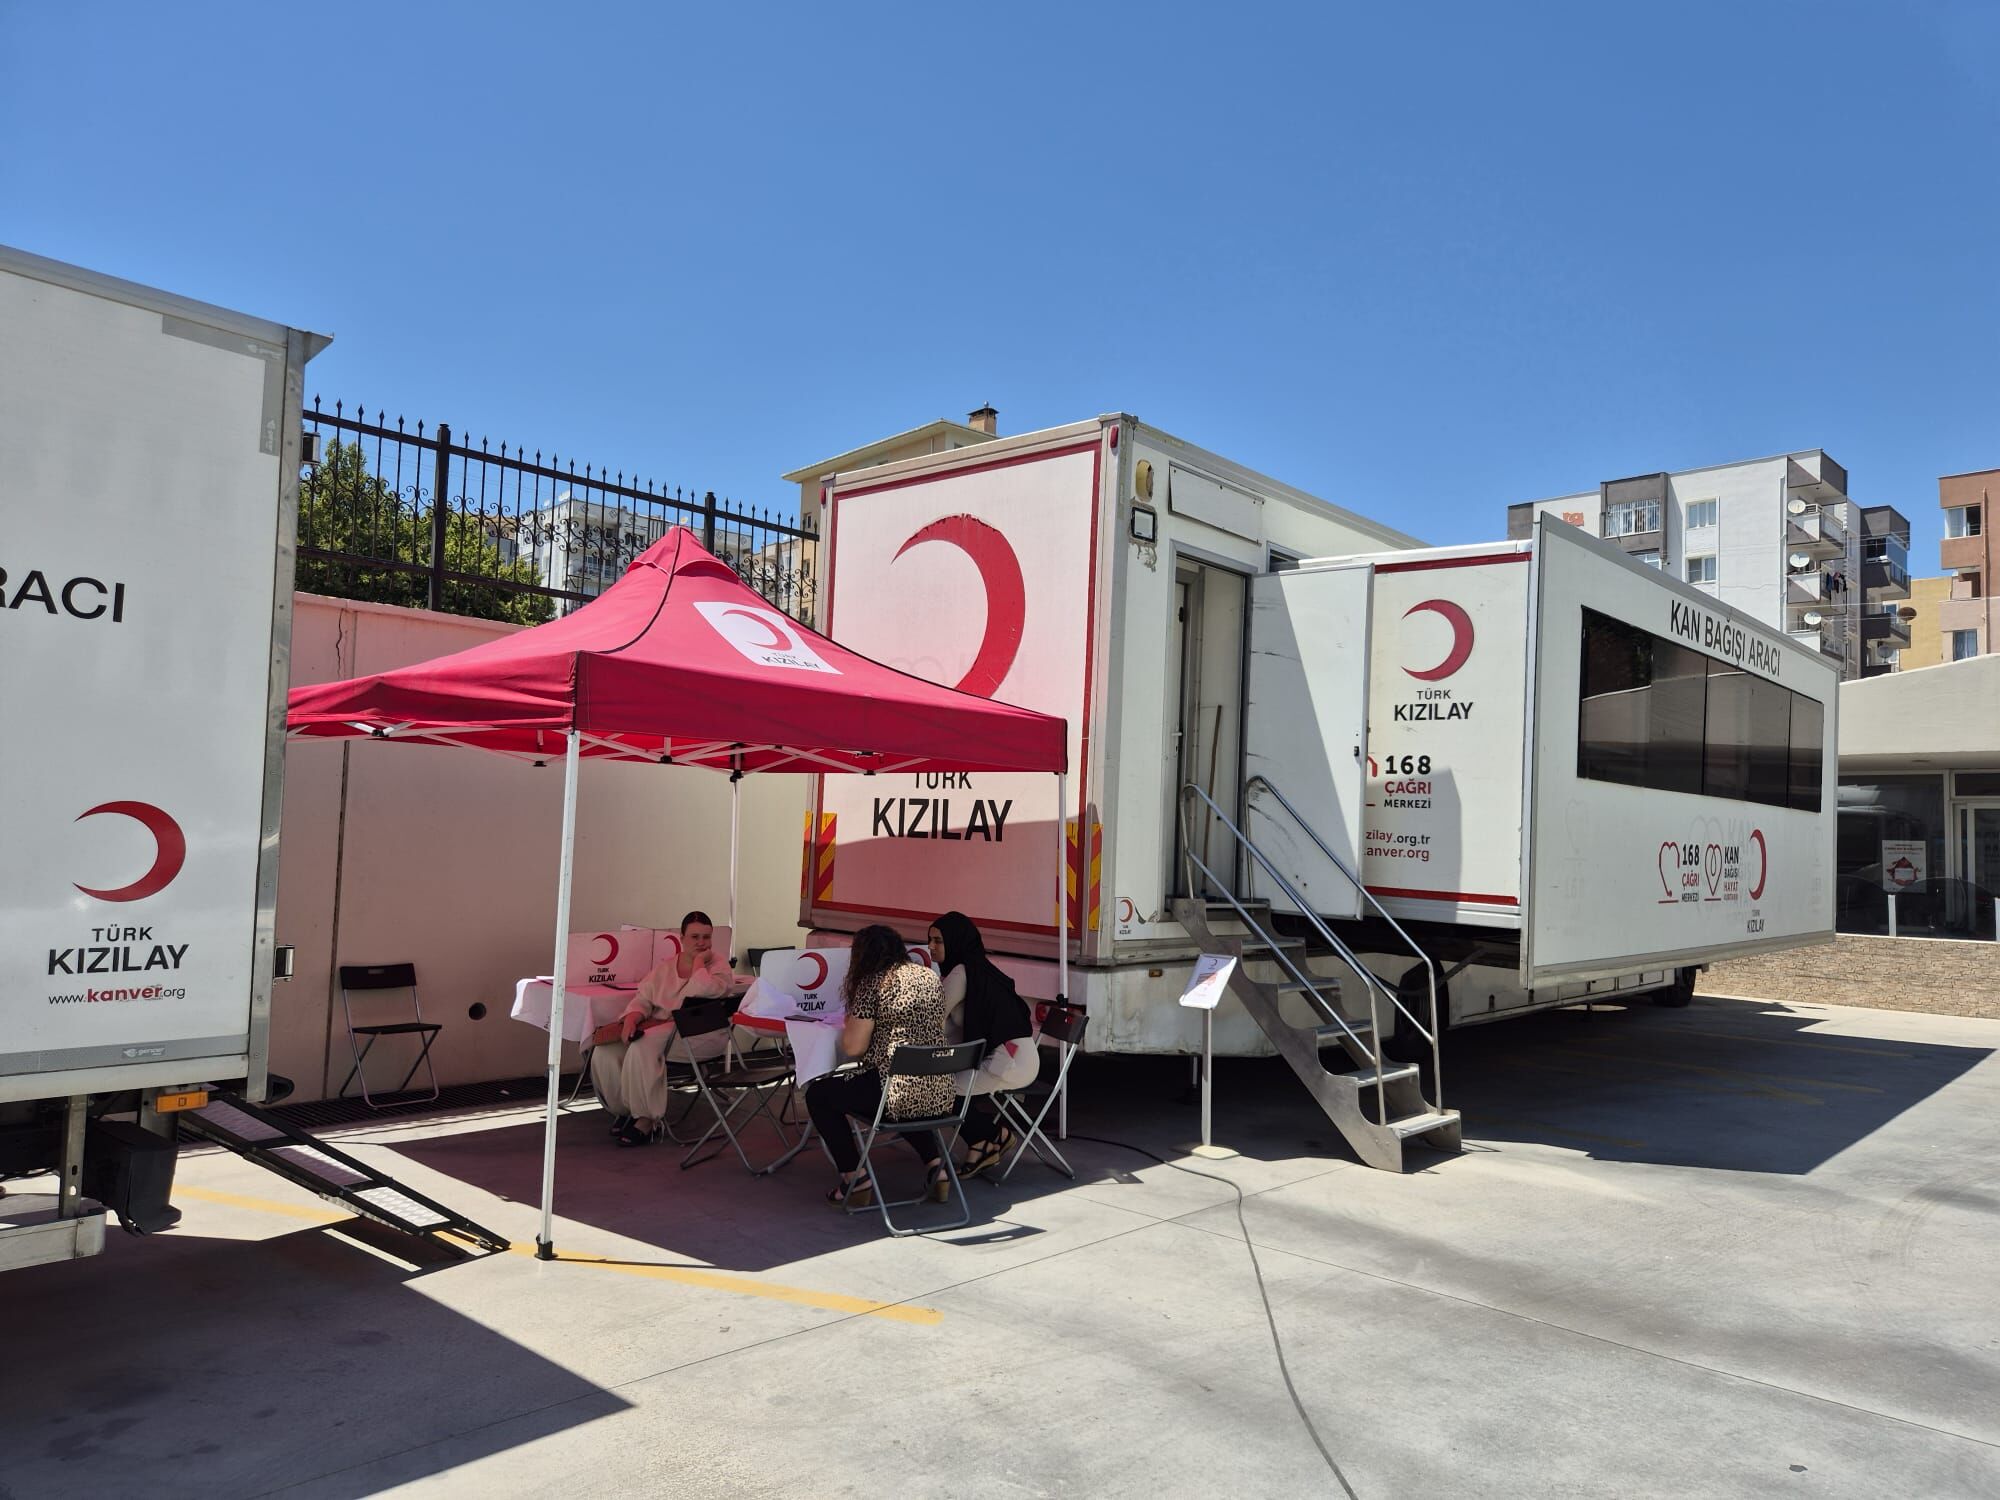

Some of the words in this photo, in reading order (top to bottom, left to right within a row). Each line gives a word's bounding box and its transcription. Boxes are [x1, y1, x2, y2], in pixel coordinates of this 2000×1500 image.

[0, 567, 125, 623] ACI
[1670, 599, 1701, 643] KAN
[1704, 616, 1746, 667] BAĞIŞI
[1748, 637, 1781, 677] ARACI
[1416, 687, 1452, 700] TÜRK
[1393, 702, 1474, 721] KIZILAY
[1385, 755, 1432, 775] 168
[1384, 779, 1432, 797] ÇAĞRI
[1384, 798, 1432, 809] MERKEZİ
[872, 797, 1014, 842] KIZILAY
[1366, 829, 1431, 847] zilay.org.tr
[1364, 847, 1430, 862] anver.org
[1682, 844, 1700, 866] 168
[1724, 846, 1740, 865] KAN
[1682, 870, 1700, 891] ÇAĞRI
[91, 923, 154, 942] TÜRK
[48, 943, 190, 976] KIZILAY
[588, 974, 617, 984] KIZILAY
[48, 985, 187, 1005] www.kanver.org
